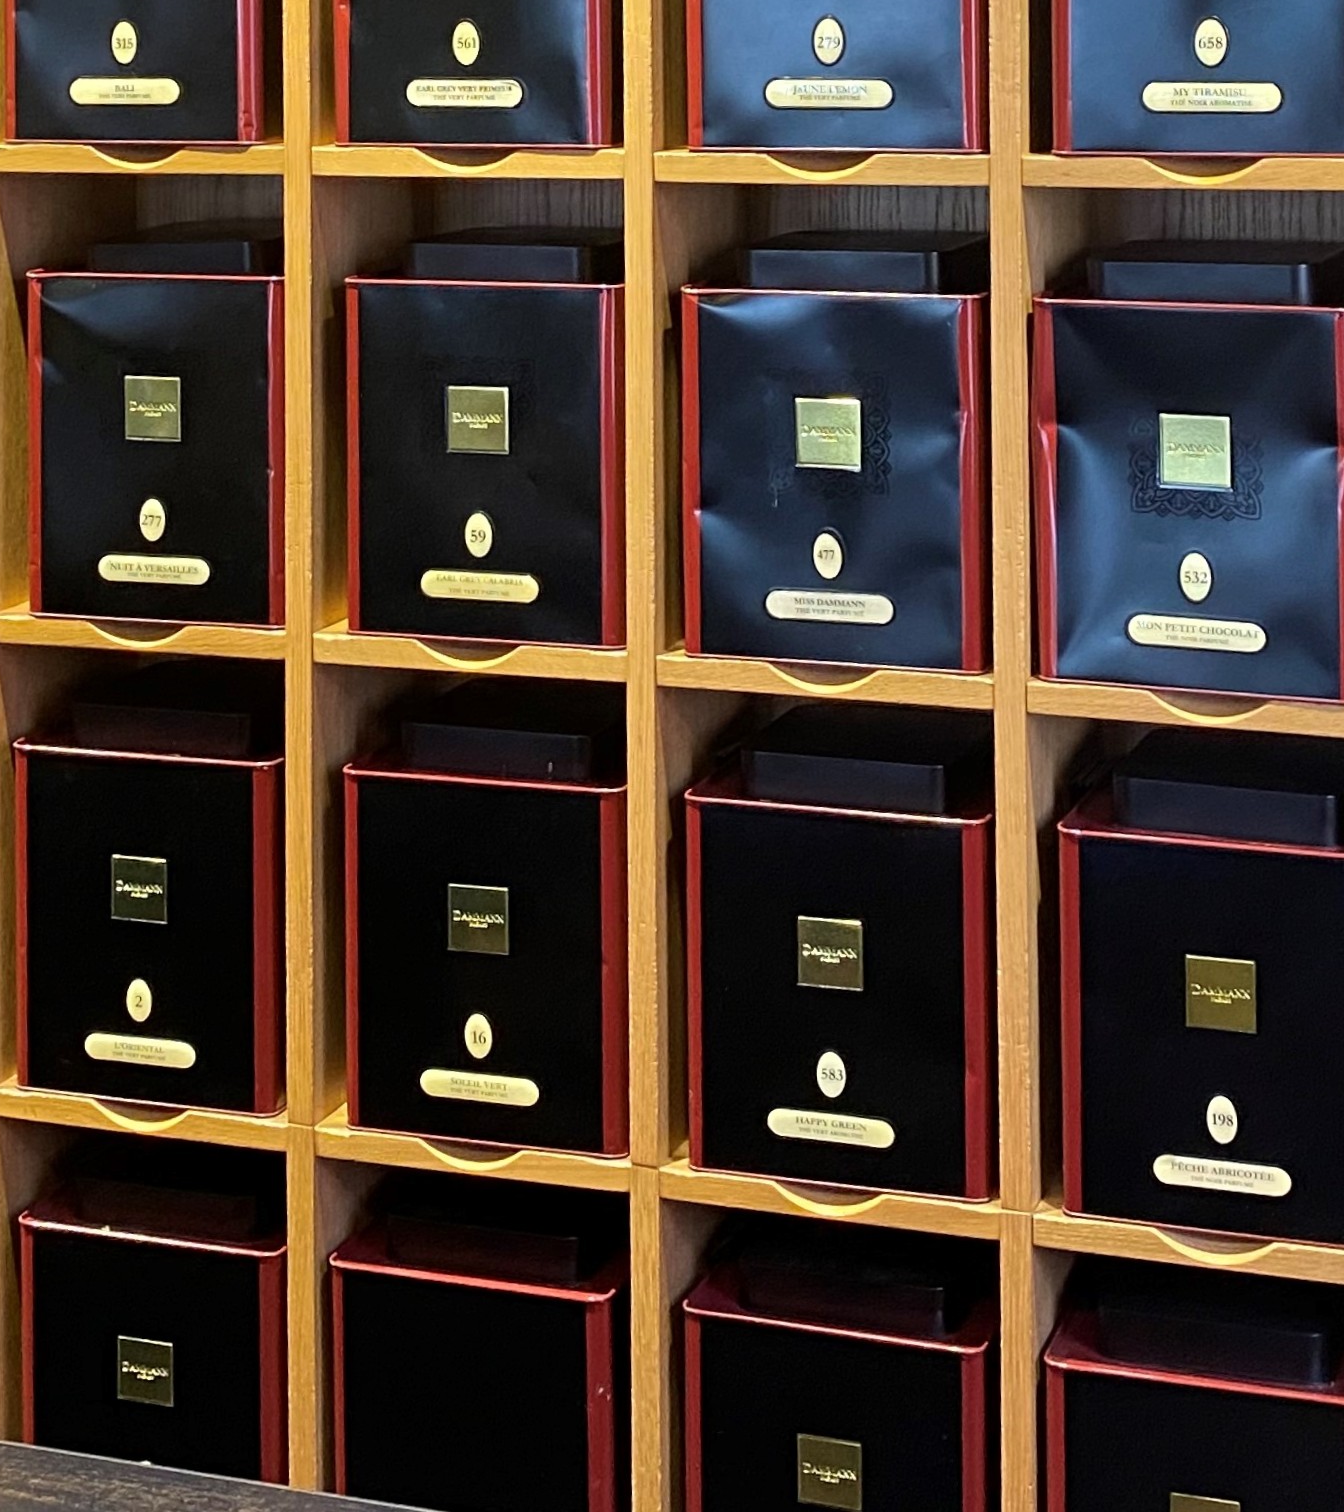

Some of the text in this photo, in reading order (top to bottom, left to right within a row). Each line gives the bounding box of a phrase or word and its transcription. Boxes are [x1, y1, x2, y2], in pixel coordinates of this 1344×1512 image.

[116, 37, 133, 49] 315
[457, 37, 476, 49] 561
[817, 36, 841, 50] 279
[1198, 36, 1223, 49] 658
[828, 85, 868, 94] LEMON
[1172, 88, 1247, 97] MY TIRAMISU
[141, 514, 162, 527] 277
[470, 529, 486, 543] 59
[817, 549, 835, 560] 477
[109, 562, 136, 572] NUIT
[144, 563, 200, 575] VERSAILLES
[436, 574, 457, 582] EARL
[1184, 571, 1208, 584] 532
[793, 597, 866, 608] MISS DAMMANN
[1136, 620, 1260, 639] MON PETIT CHOCOLAT
[135, 995, 143, 1008] 2
[472, 1031, 486, 1044] 16
[822, 1068, 843, 1081] 583
[449, 1078, 508, 1091] SOLEIL VERT
[795, 1116, 867, 1132] HAPPY GREEN
[1213, 1113, 1234, 1126] 198
[1170, 1160, 1276, 1181] PÊCHE ABRICOTÉE
